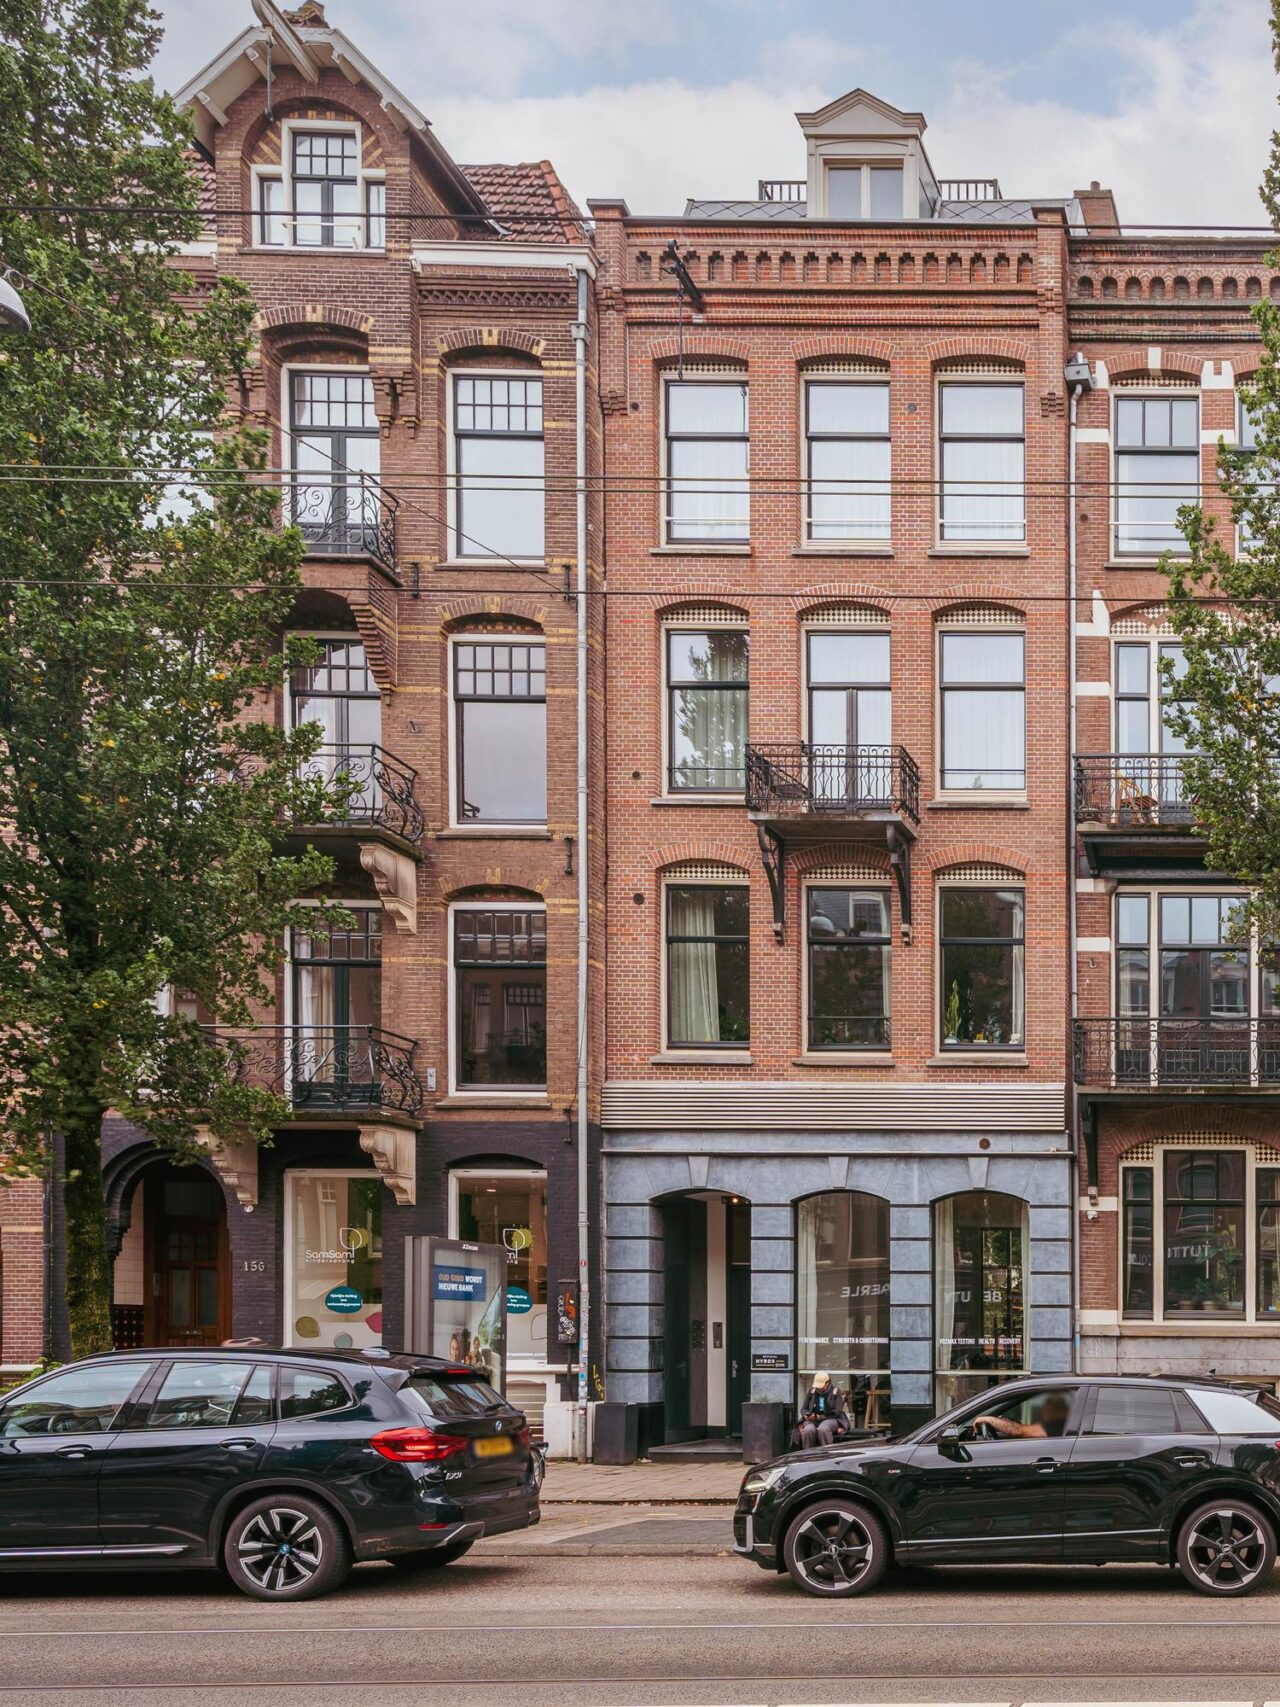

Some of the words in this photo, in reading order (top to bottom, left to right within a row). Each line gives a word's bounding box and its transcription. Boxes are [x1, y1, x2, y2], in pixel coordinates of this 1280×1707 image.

[305, 1249, 354, 1259] SamSam
[244, 1261, 265, 1271] 156
[465, 1275, 483, 1283] WORDT
[438, 1282, 458, 1291] NIEUWE
[459, 1284, 474, 1292] BANK
[978, 1337, 996, 1345] HEALTH
[998, 1337, 1021, 1345] RECOVERY
